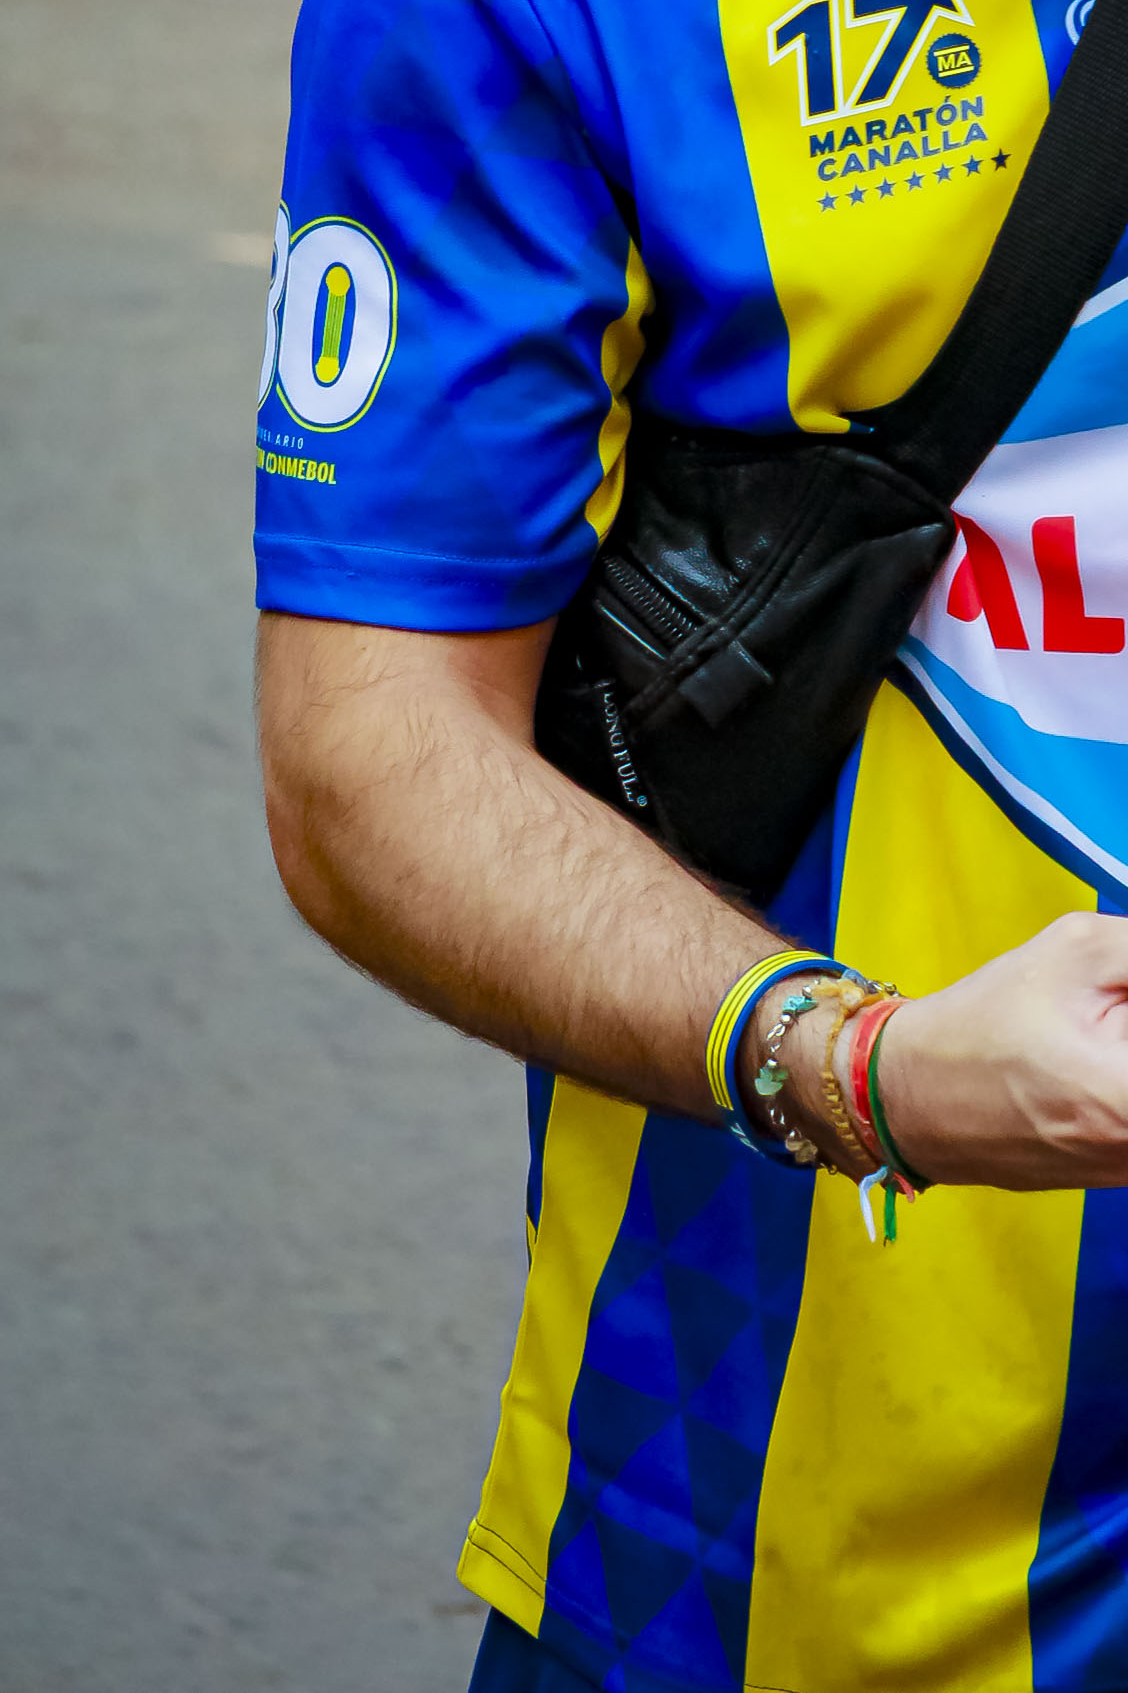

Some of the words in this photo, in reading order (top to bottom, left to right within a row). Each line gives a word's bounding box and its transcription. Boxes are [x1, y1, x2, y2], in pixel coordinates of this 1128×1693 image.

[937, 51, 973, 71] MA
[808, 95, 986, 158] MARATÓN
[816, 122, 989, 183] CANALLA
